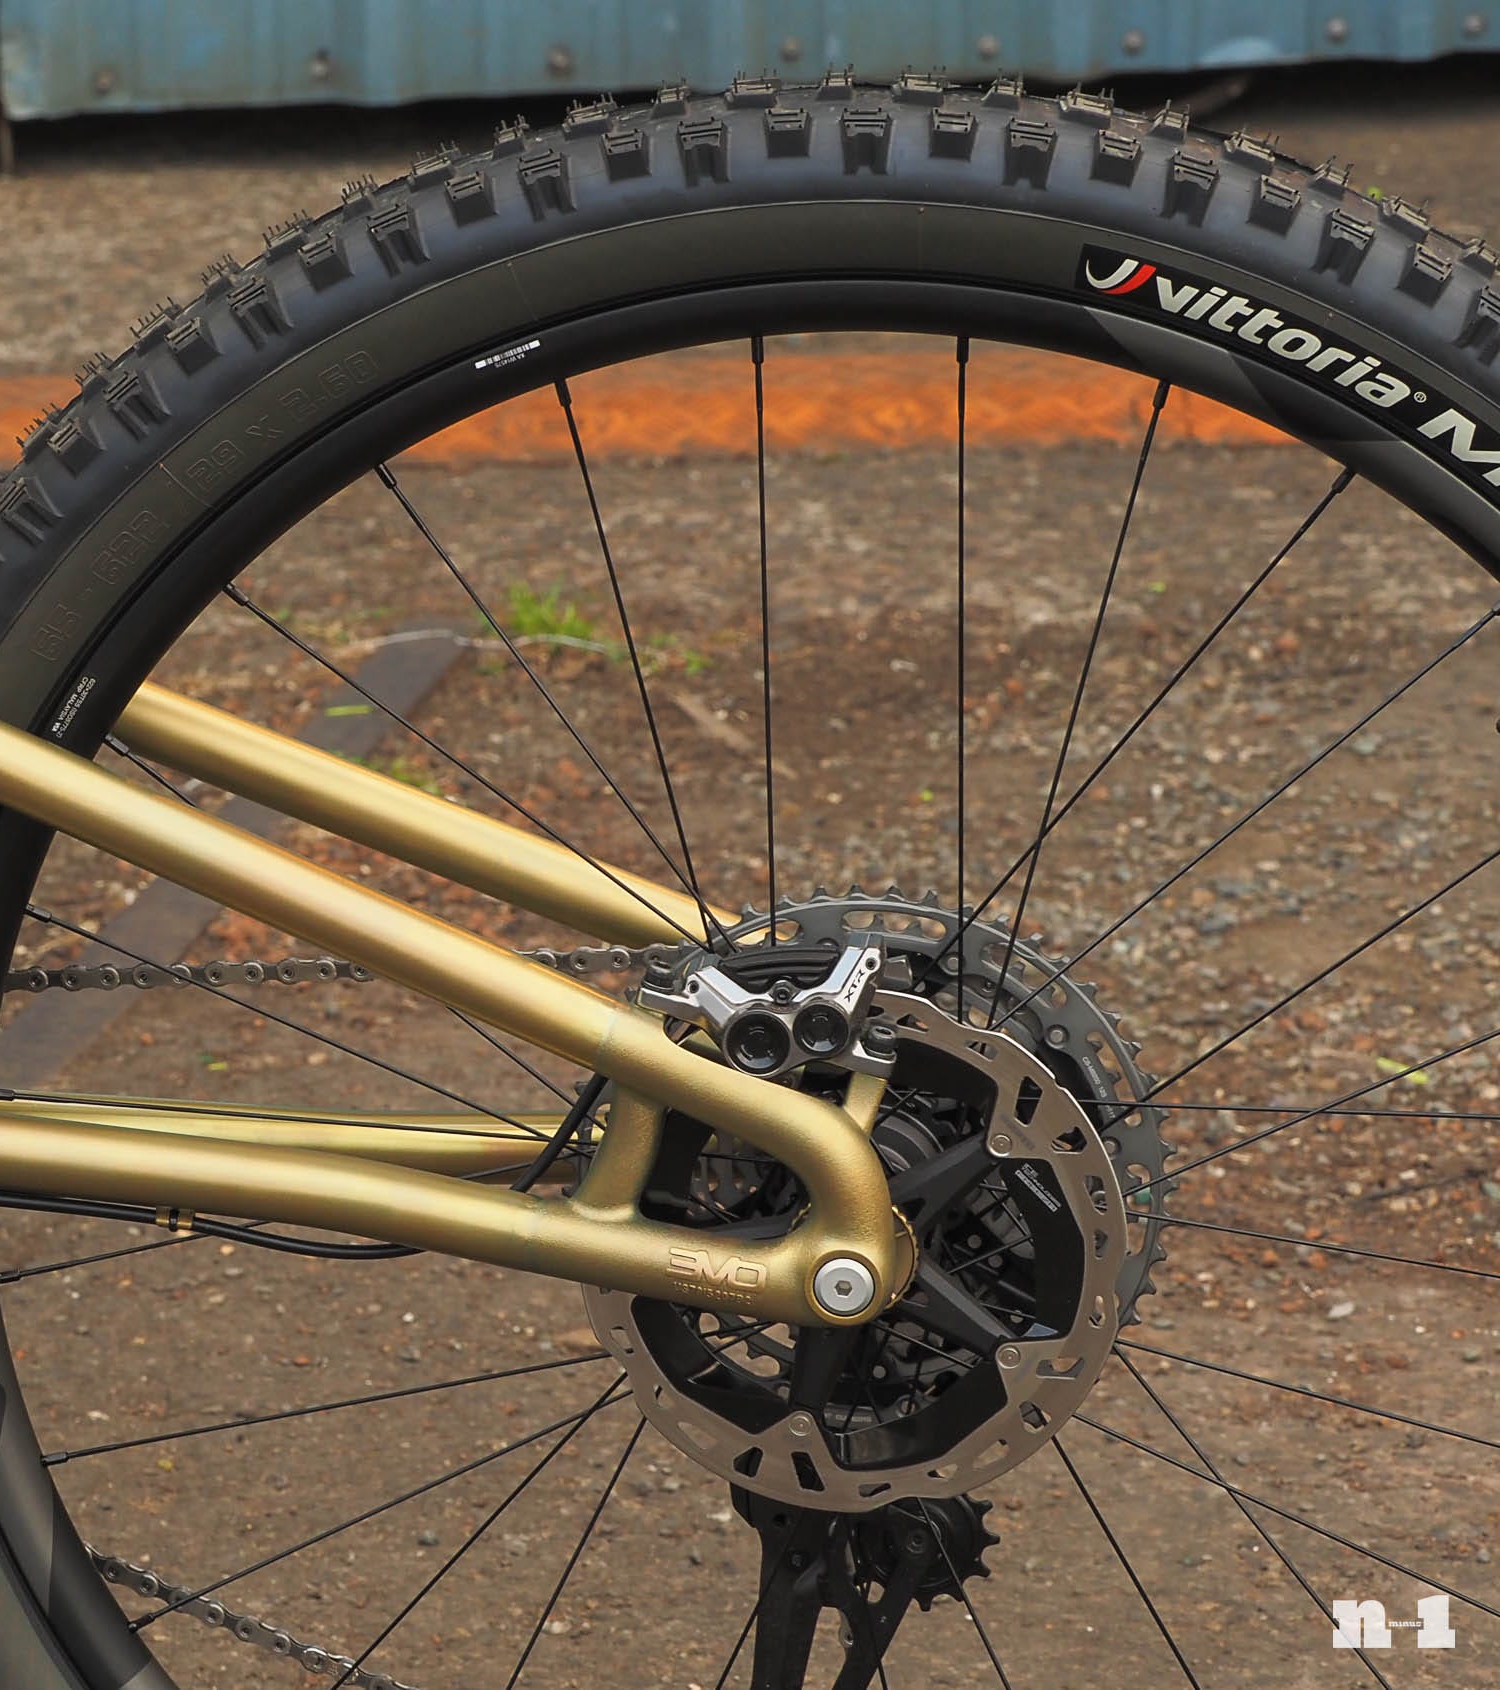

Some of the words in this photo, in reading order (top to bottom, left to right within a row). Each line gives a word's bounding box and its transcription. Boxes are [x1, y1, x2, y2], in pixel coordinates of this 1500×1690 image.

[1155, 275, 1412, 408] vittoria
[188, 438, 246, 495] 29
[843, 967, 869, 1002] XTR
